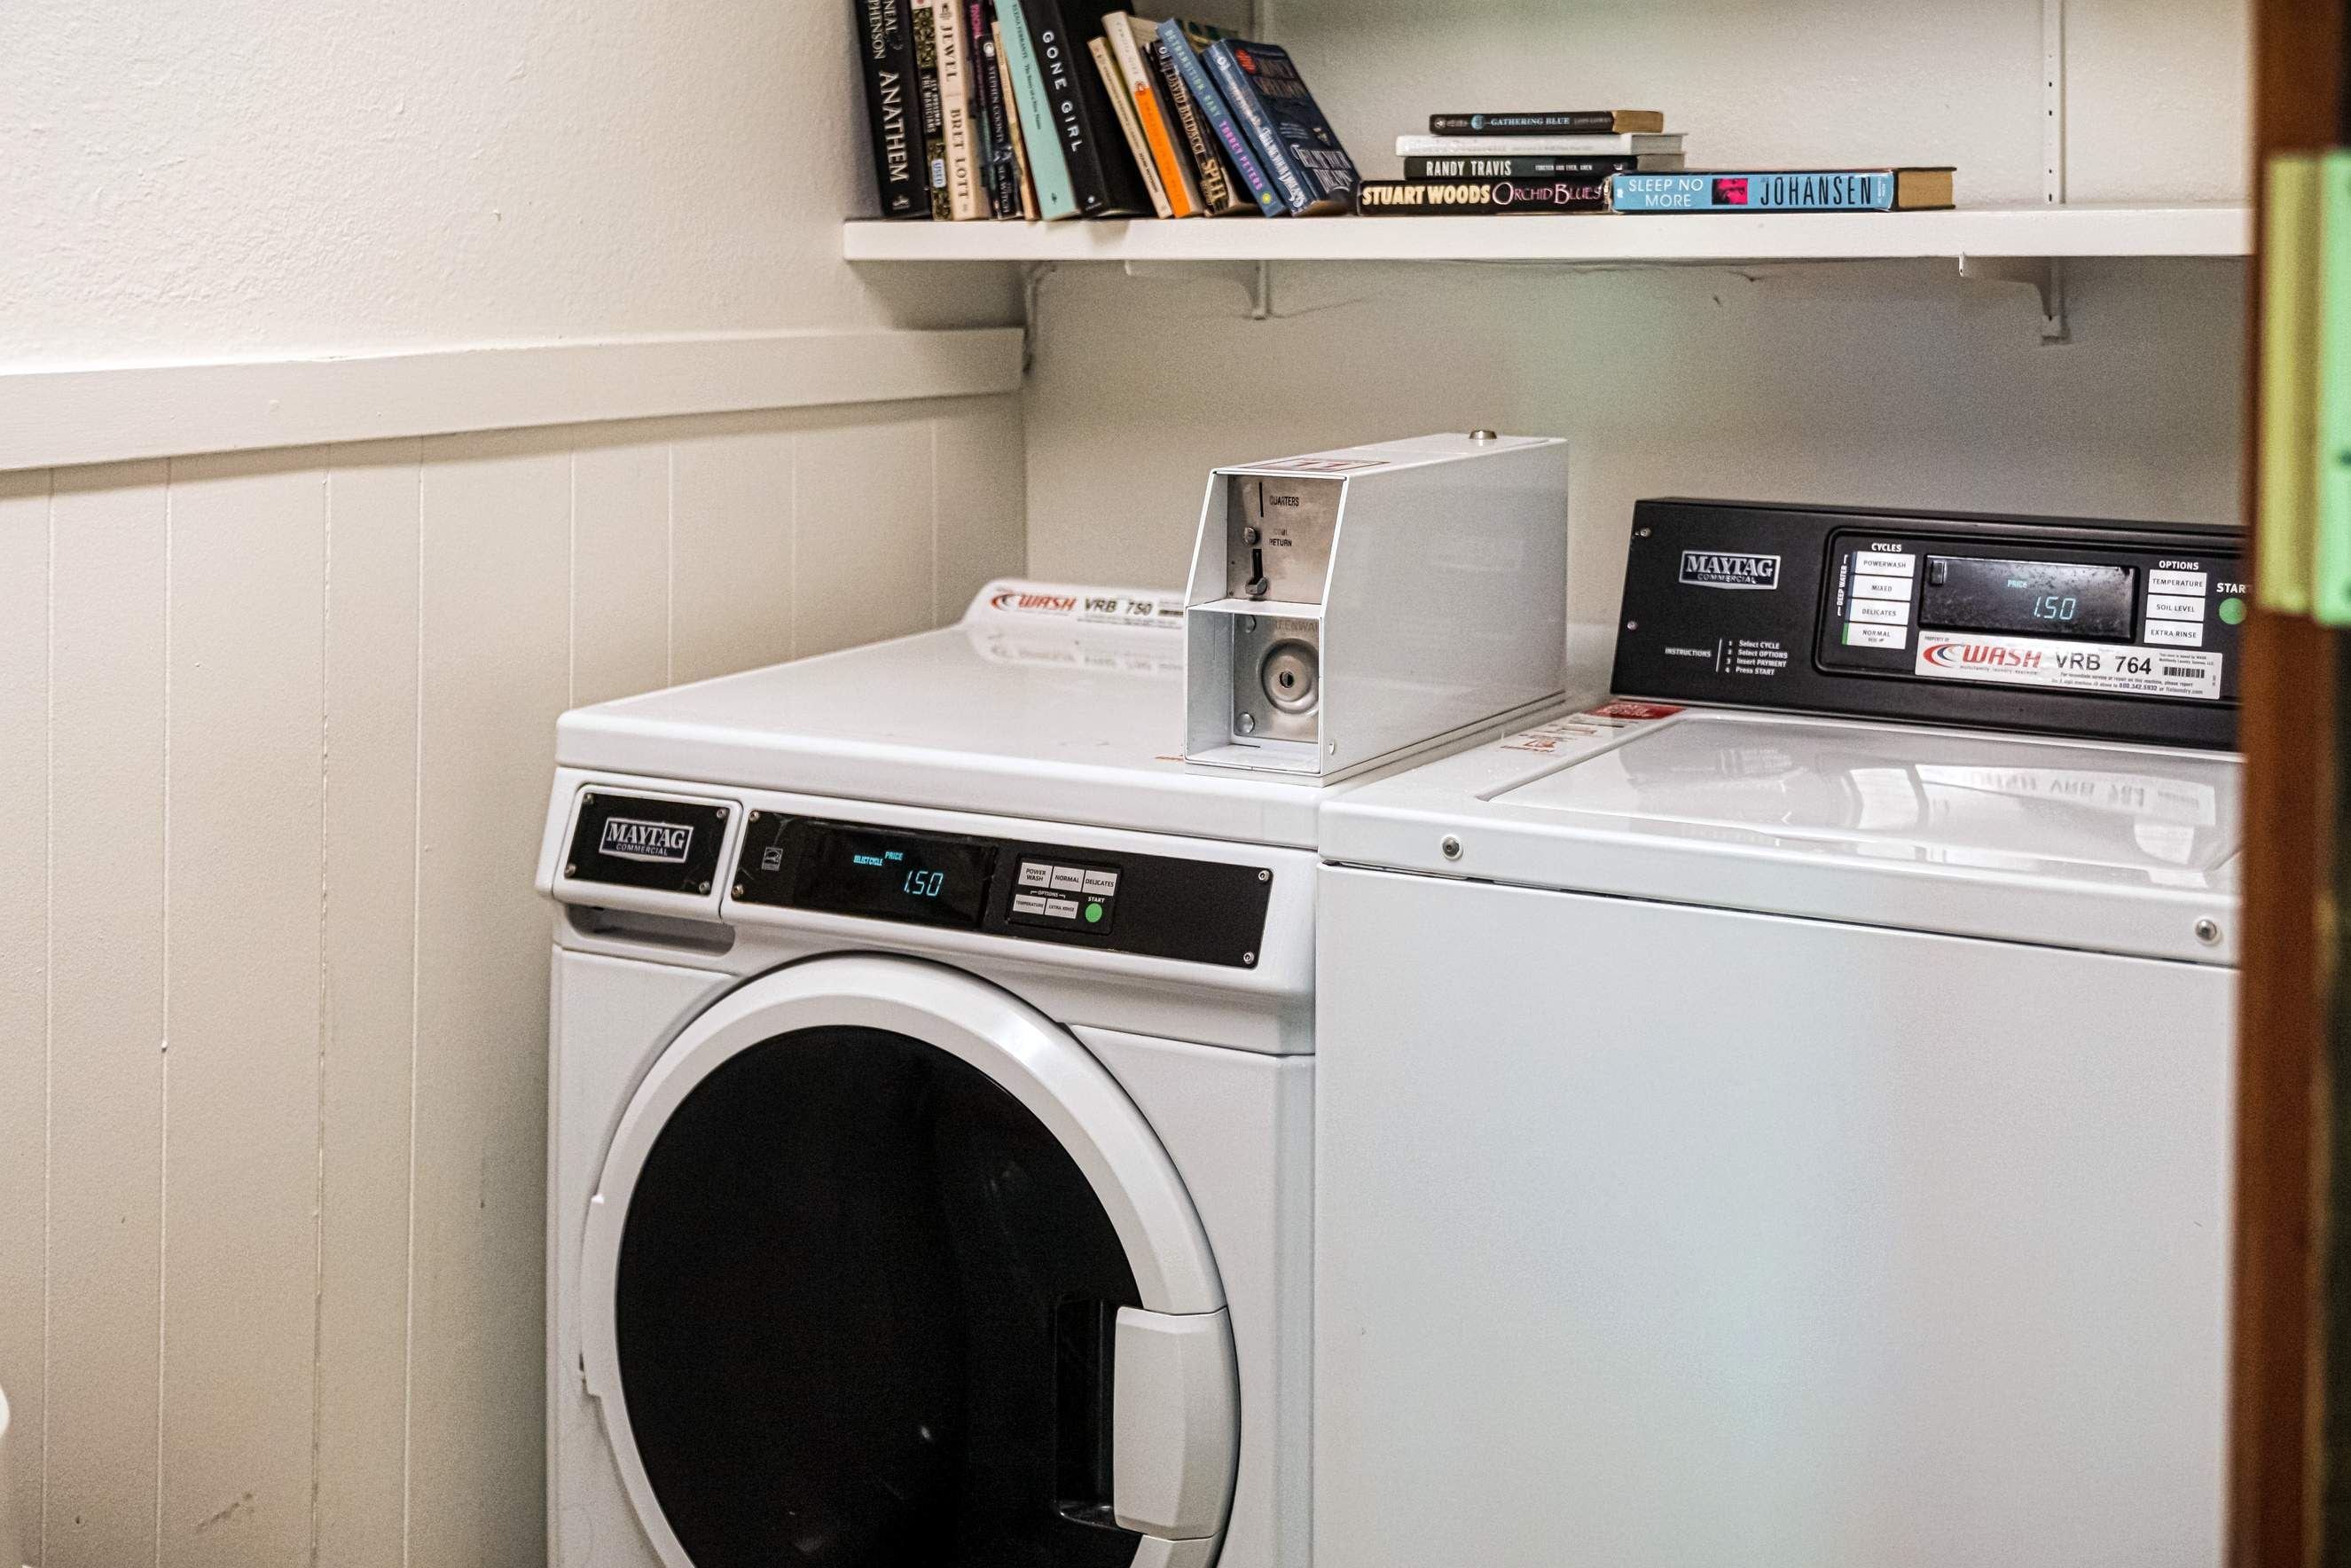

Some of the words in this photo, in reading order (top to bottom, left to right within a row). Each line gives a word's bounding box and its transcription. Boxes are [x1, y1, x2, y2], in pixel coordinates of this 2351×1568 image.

[939, 26, 959, 82] JEWEL
[1042, 30, 1068, 90] GONE
[1061, 100, 1084, 153] GIRL
[1167, 74, 1185, 107] DAVID
[1179, 104, 1205, 154] BALDACCI
[879, 71, 909, 184] ANATHEM
[1490, 116, 1544, 126] GATHERING
[1545, 116, 1571, 125] BLUE
[950, 108, 965, 150] BRET
[1425, 161, 1465, 176] RANDY
[1470, 161, 1512, 176] TRAVIS
[954, 156, 969, 200] LOTT
[1203, 159, 1226, 200] SPLIT
[1628, 178, 1671, 192] SLEEP
[1678, 178, 1704, 192] NO
[1759, 176, 1871, 206] JOHANSEN
[1362, 185, 1426, 205] STUART
[1427, 184, 1491, 205] WOODS
[1645, 193, 1692, 207] MORE
[1269, 496, 1299, 507] QUARTERS
[1269, 538, 1292, 547] RETURN
[1871, 543, 1902, 553] CYCLES
[1686, 555, 1774, 576] MAYTAG
[1863, 560, 1907, 568] POWERWASH
[2159, 560, 2199, 570] OPTIONS
[1697, 573, 1757, 584] COMMERCIAL
[1838, 565, 1847, 588] WATER
[2152, 578, 2204, 588] TEMPERATURE
[2216, 583, 2247, 593] STAR
[1836, 588, 1845, 606] DEEP
[1019, 594, 1078, 612] WASH
[1085, 599, 1117, 613] VRB
[1125, 601, 1153, 616] 750
[2034, 596, 2077, 621] 1.50
[2156, 603, 2173, 612] SOIL
[1862, 629, 1891, 638] NORMAL
[2151, 629, 2174, 638] EXTRA
[2175, 630, 2198, 639] RINSE
[1739, 639, 1759, 648] Select
[1665, 647, 1712, 657] INSTRUCTIONS
[1738, 648, 1758, 657] Select
[1759, 650, 1788, 659] OPTIONS
[1963, 645, 2042, 668] WASH
[1736, 657, 1756, 666] Insert
[2056, 652, 2100, 671] VRB
[2114, 656, 2151, 675] 764
[607, 823, 686, 849] MAYTAG
[615, 843, 668, 856] COMMERCIAL
[885, 851, 903, 860] PRICE
[904, 870, 944, 896] 1.50
[1054, 874, 1079, 883] NORMAL
[1085, 878, 1115, 888] DELICATES
[1015, 899, 1044, 908] TEMPERATURE
